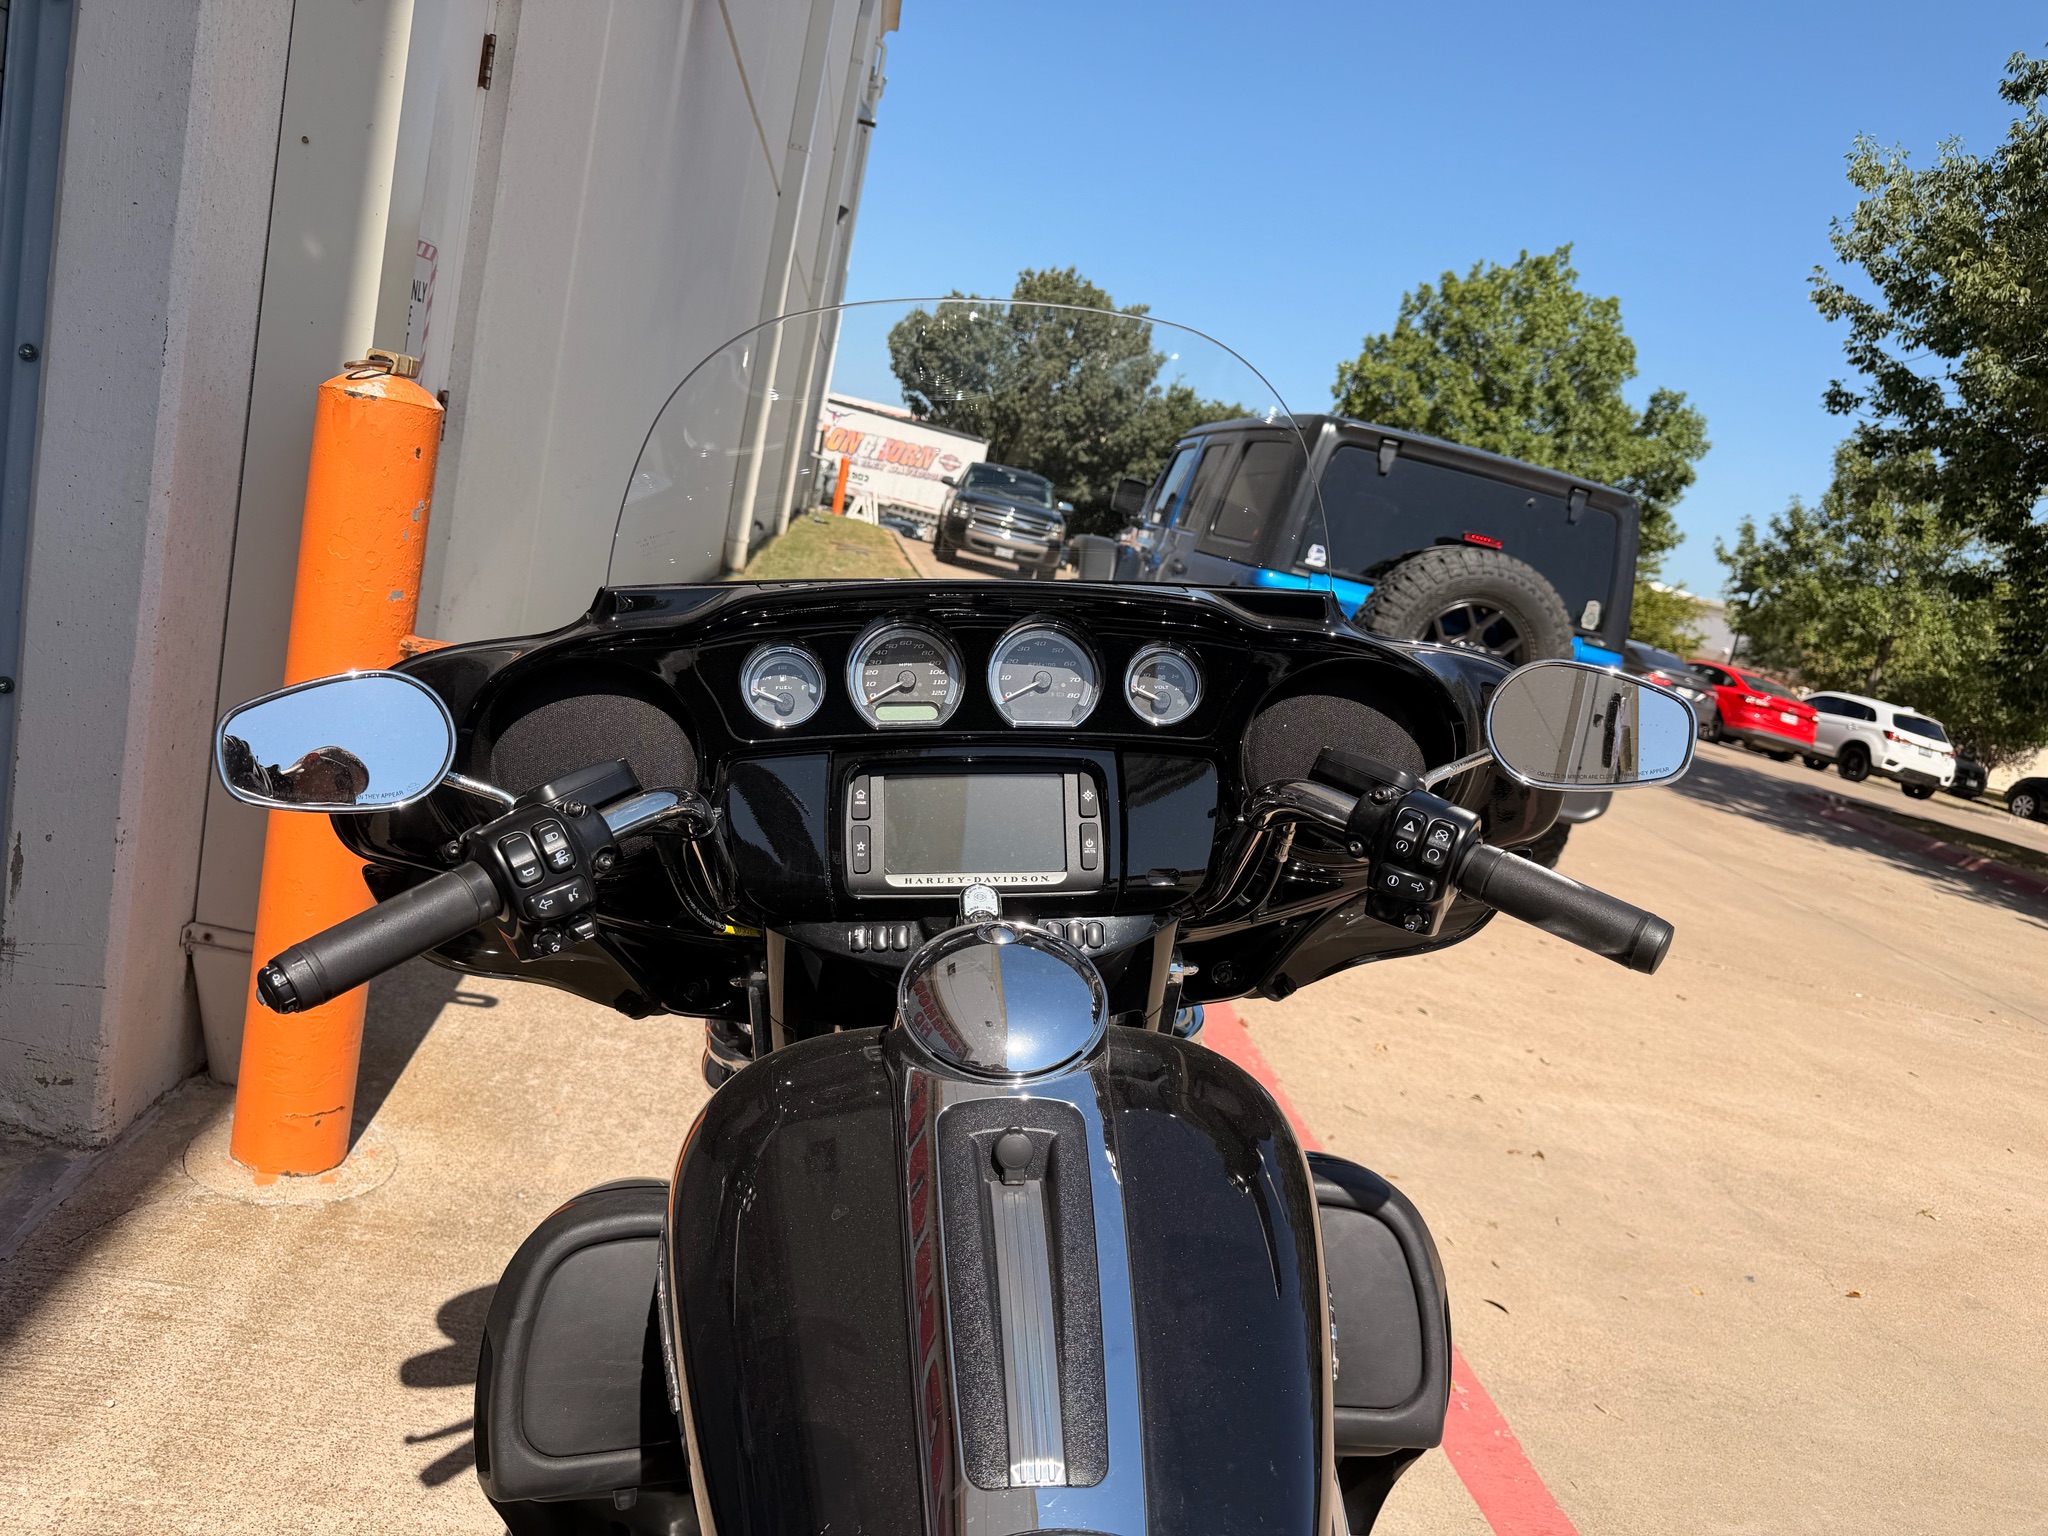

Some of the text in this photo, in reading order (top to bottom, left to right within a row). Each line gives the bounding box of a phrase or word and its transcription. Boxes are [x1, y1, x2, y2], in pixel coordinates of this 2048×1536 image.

[410, 279, 428, 303] NLY
[381, 790, 404, 798] APPEAR
[904, 874, 1050, 884] HARLEY-DAVIDSON
